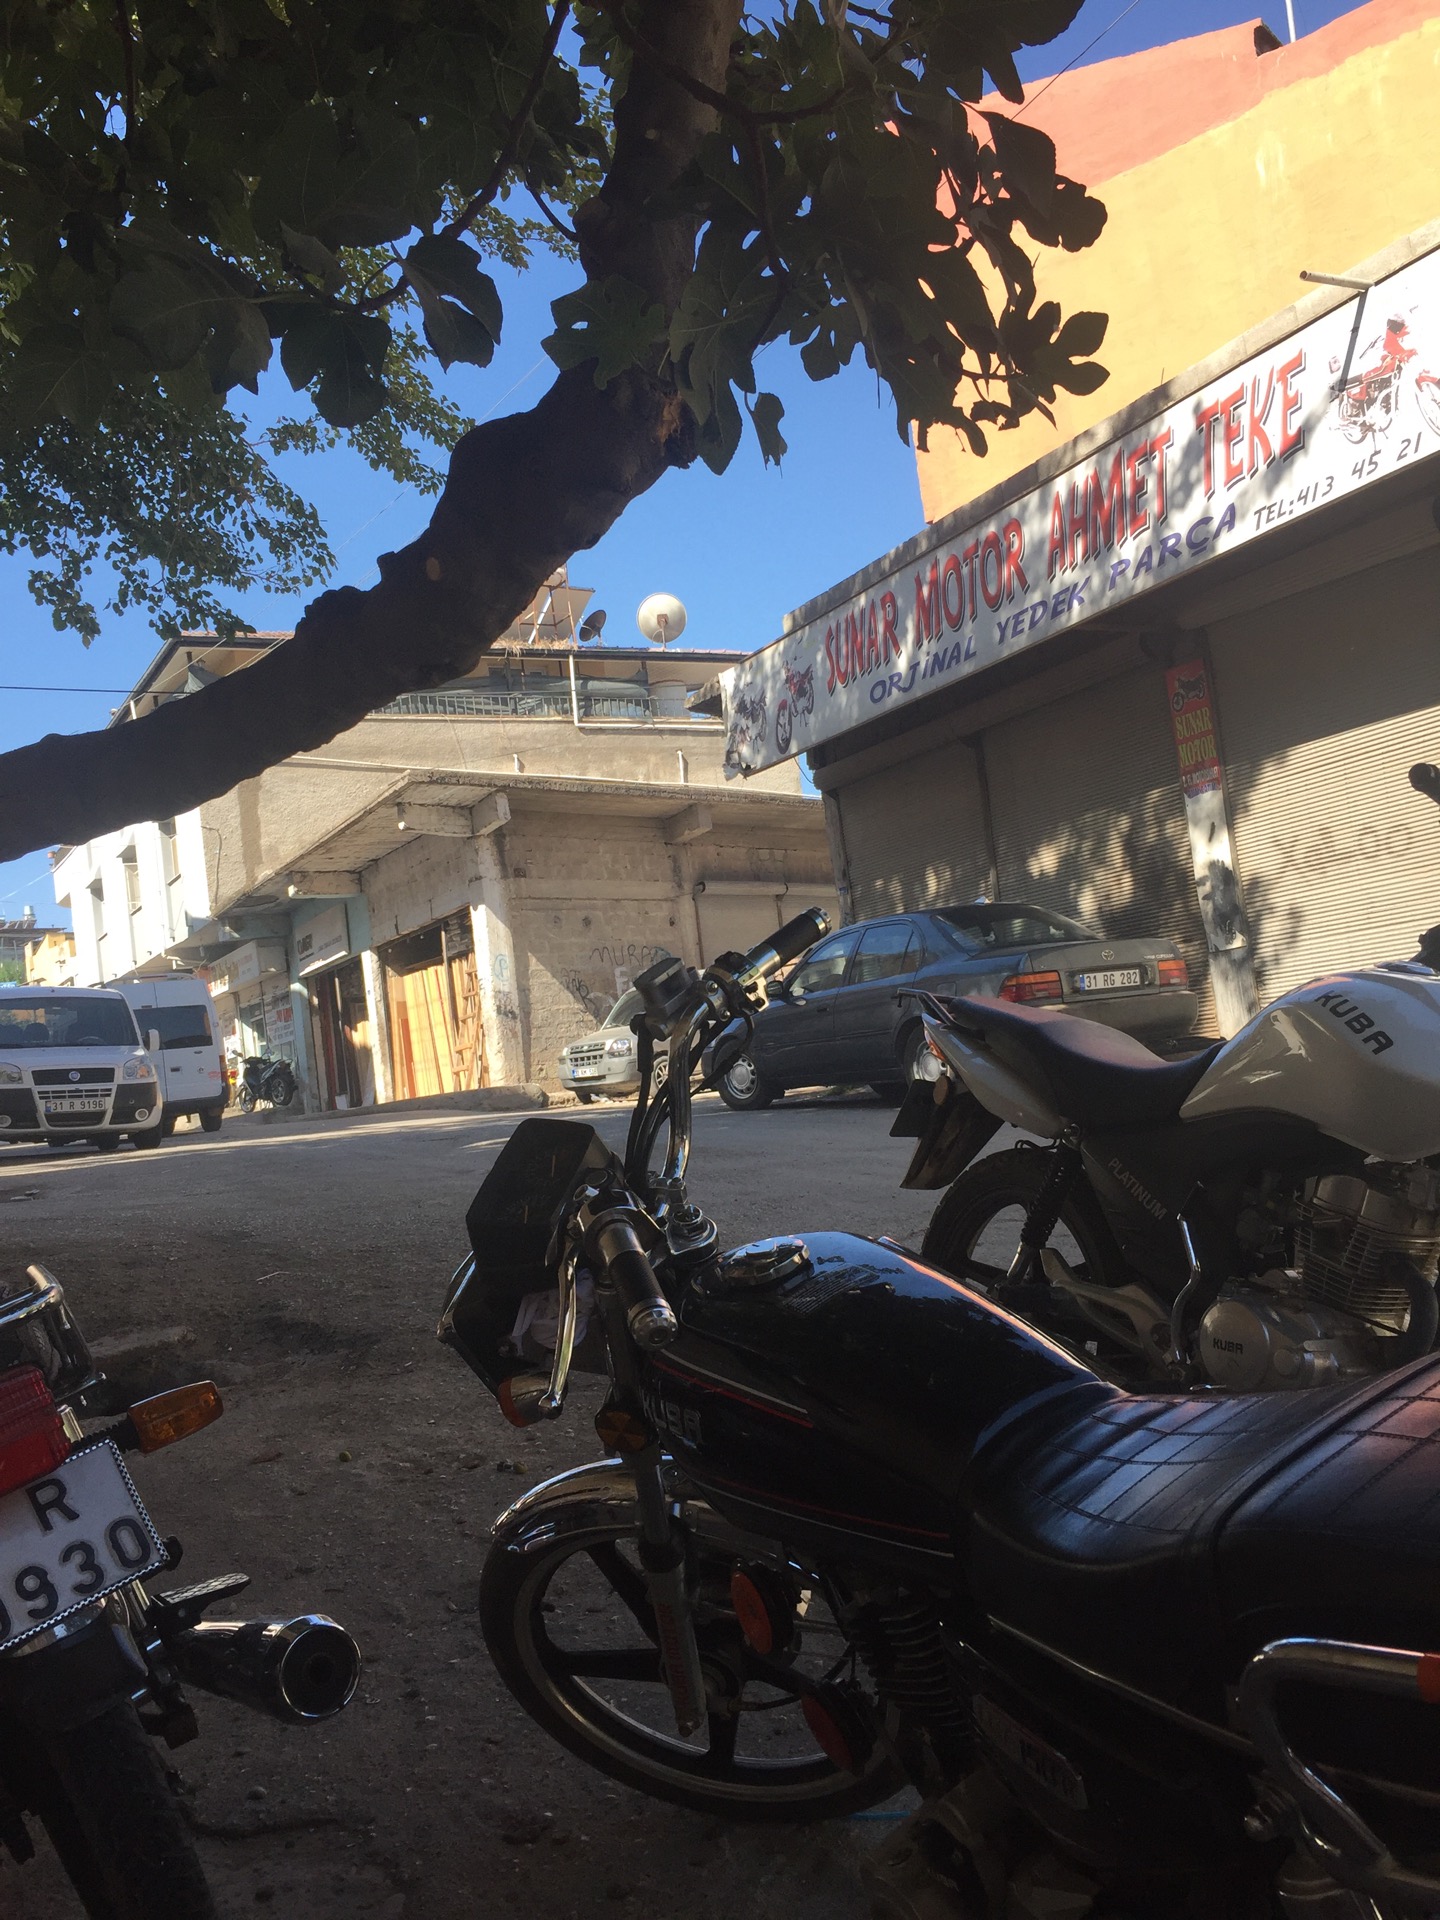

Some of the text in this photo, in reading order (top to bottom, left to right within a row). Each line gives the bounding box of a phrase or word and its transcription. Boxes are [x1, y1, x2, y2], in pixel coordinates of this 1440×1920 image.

[1351, 450, 1382, 480] 45
[1396, 432, 1422, 462] 21
[825, 348, 1306, 696] SUNAR MOTOR AHMET TEKE
[996, 576, 1091, 645] YEDEK
[1108, 503, 1236, 591] PARÇA
[1175, 707, 1212, 740] SUNAR
[1179, 734, 1217, 768] MOTOR
[1085, 971, 1139, 988] 31 RG 282
[1314, 990, 1394, 1055] KUBA
[52, 1100, 104, 1111] 31 R 9196
[1108, 1158, 1168, 1220] PLATINUM
[1213, 1338, 1244, 1355] KUBA
[641, 1389, 703, 1443] KUBA
[25, 1478, 79, 1532] R
[0, 1518, 150, 1640] 930
